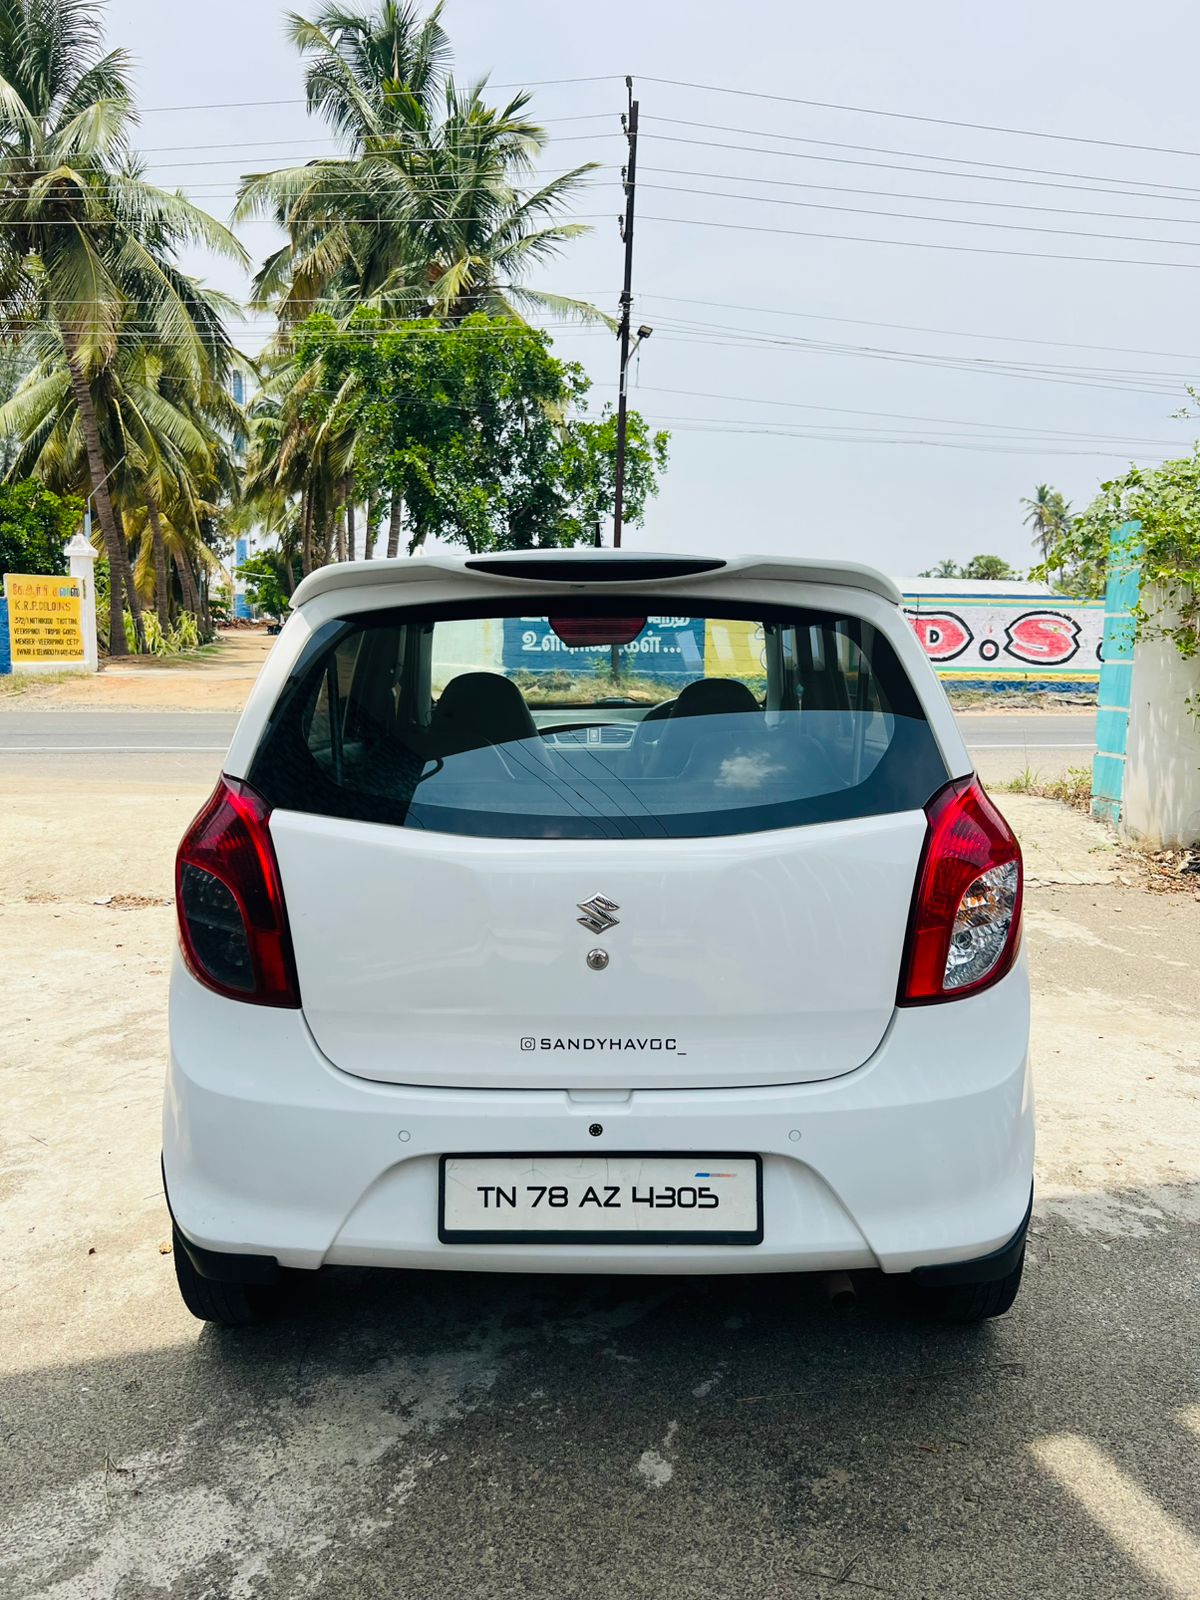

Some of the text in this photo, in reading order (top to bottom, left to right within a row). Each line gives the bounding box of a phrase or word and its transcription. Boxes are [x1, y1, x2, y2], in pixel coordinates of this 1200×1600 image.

[540, 1038, 686, 1055] SANDYHAVOC_
[477, 1186, 719, 1209] TN 78 AZ 4305
